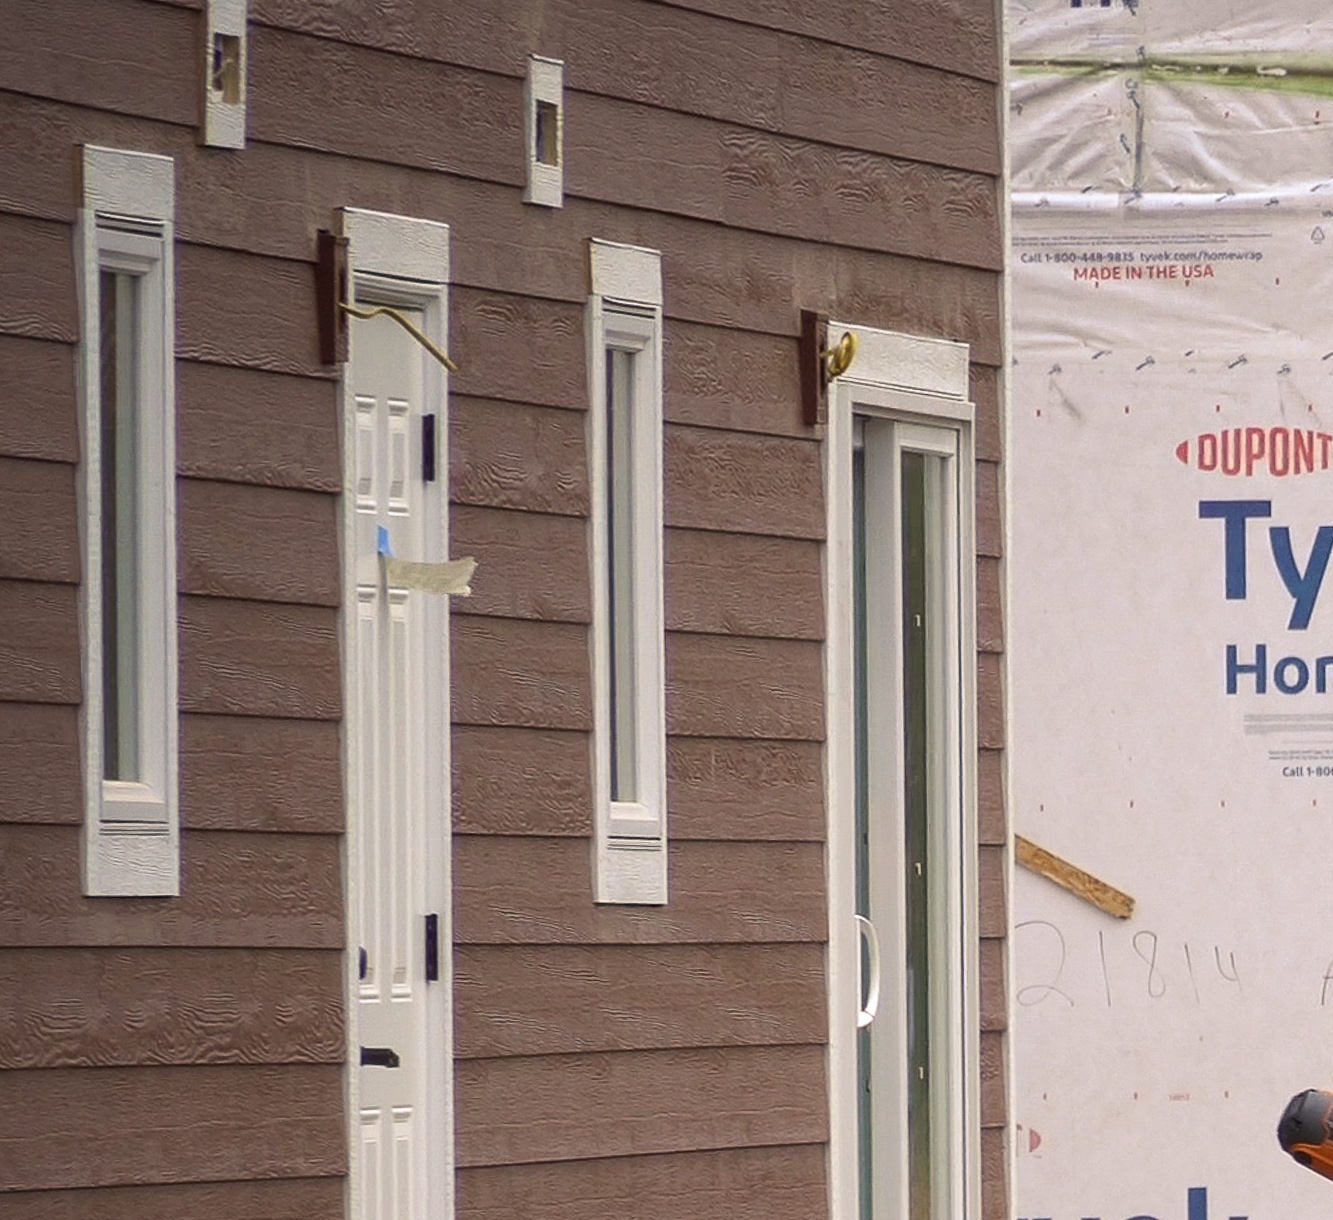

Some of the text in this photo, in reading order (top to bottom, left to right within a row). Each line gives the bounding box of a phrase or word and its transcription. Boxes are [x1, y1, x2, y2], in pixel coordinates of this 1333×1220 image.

[1021, 252, 1043, 264] Call
[1074, 264, 1214, 281] MADE IN THE USA
[1198, 427, 1333, 477] DUPONT
[1282, 765, 1303, 777] Call
[1014, 920, 1243, 1008] 21814
